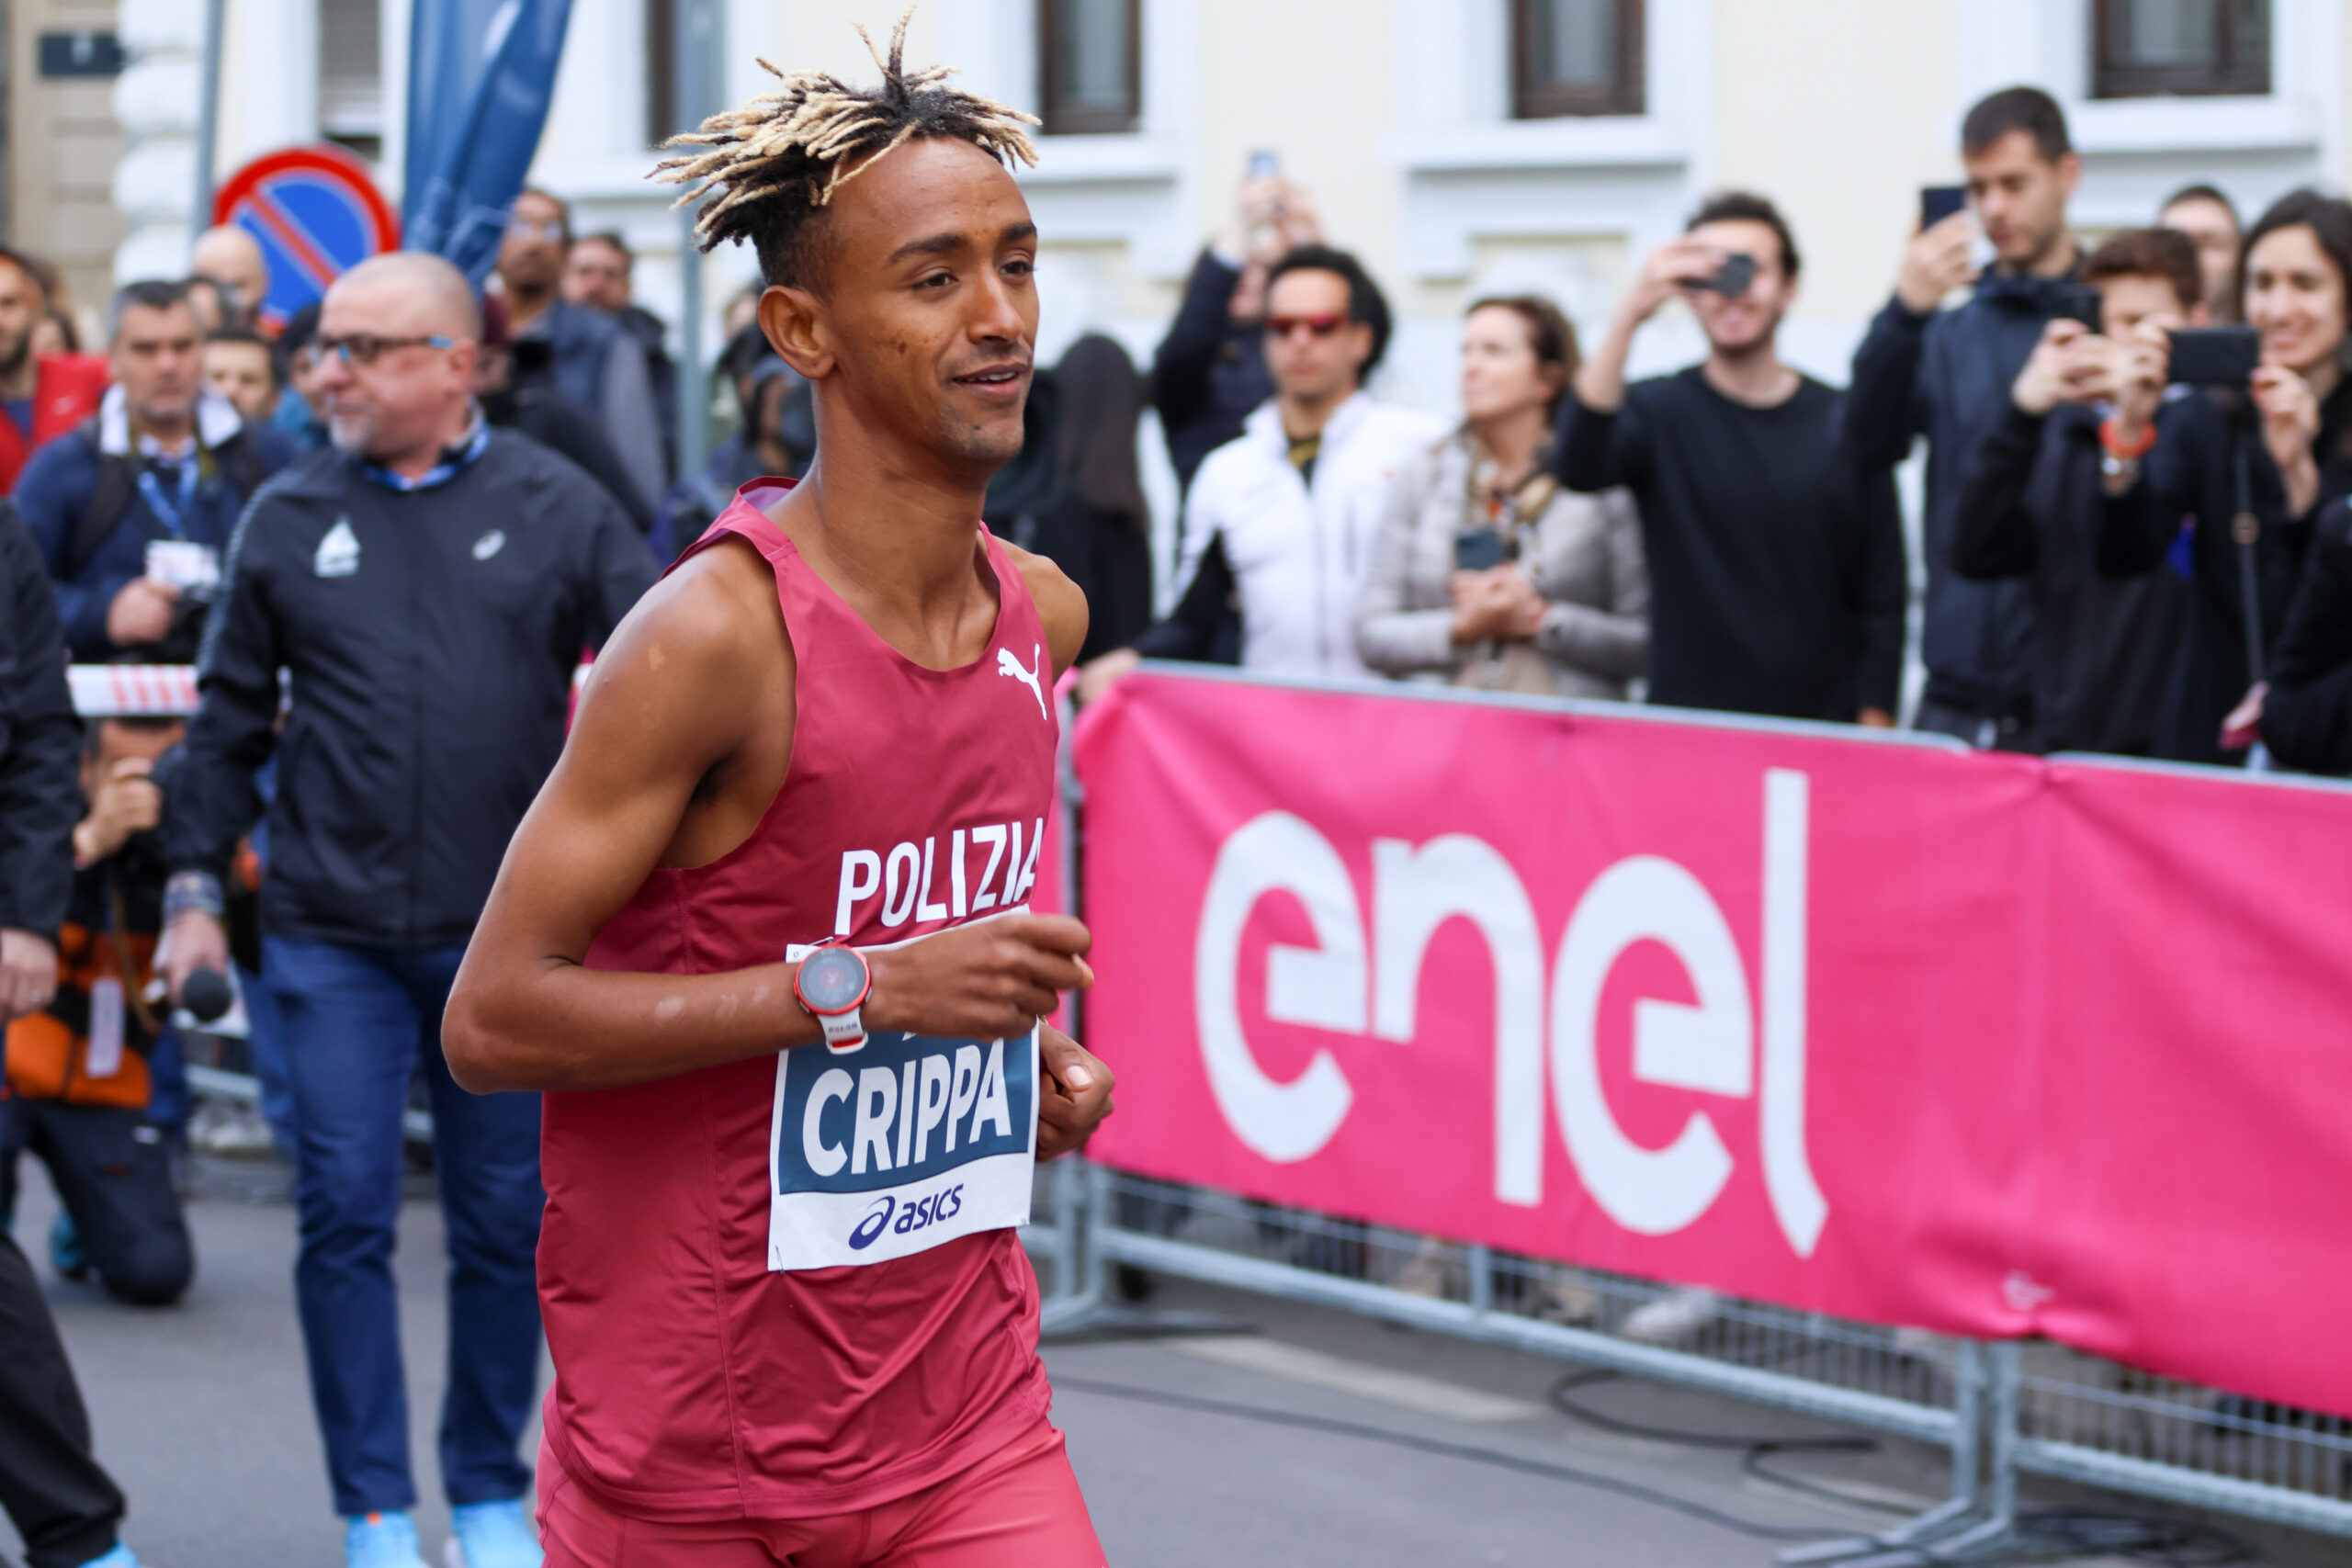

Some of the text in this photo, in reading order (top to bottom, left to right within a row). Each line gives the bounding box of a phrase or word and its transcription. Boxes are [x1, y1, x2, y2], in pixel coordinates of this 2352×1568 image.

[1195, 766, 1829, 1260] enel
[802, 1038, 1012, 1177] CRIPPA
[894, 1183, 964, 1235] asics
